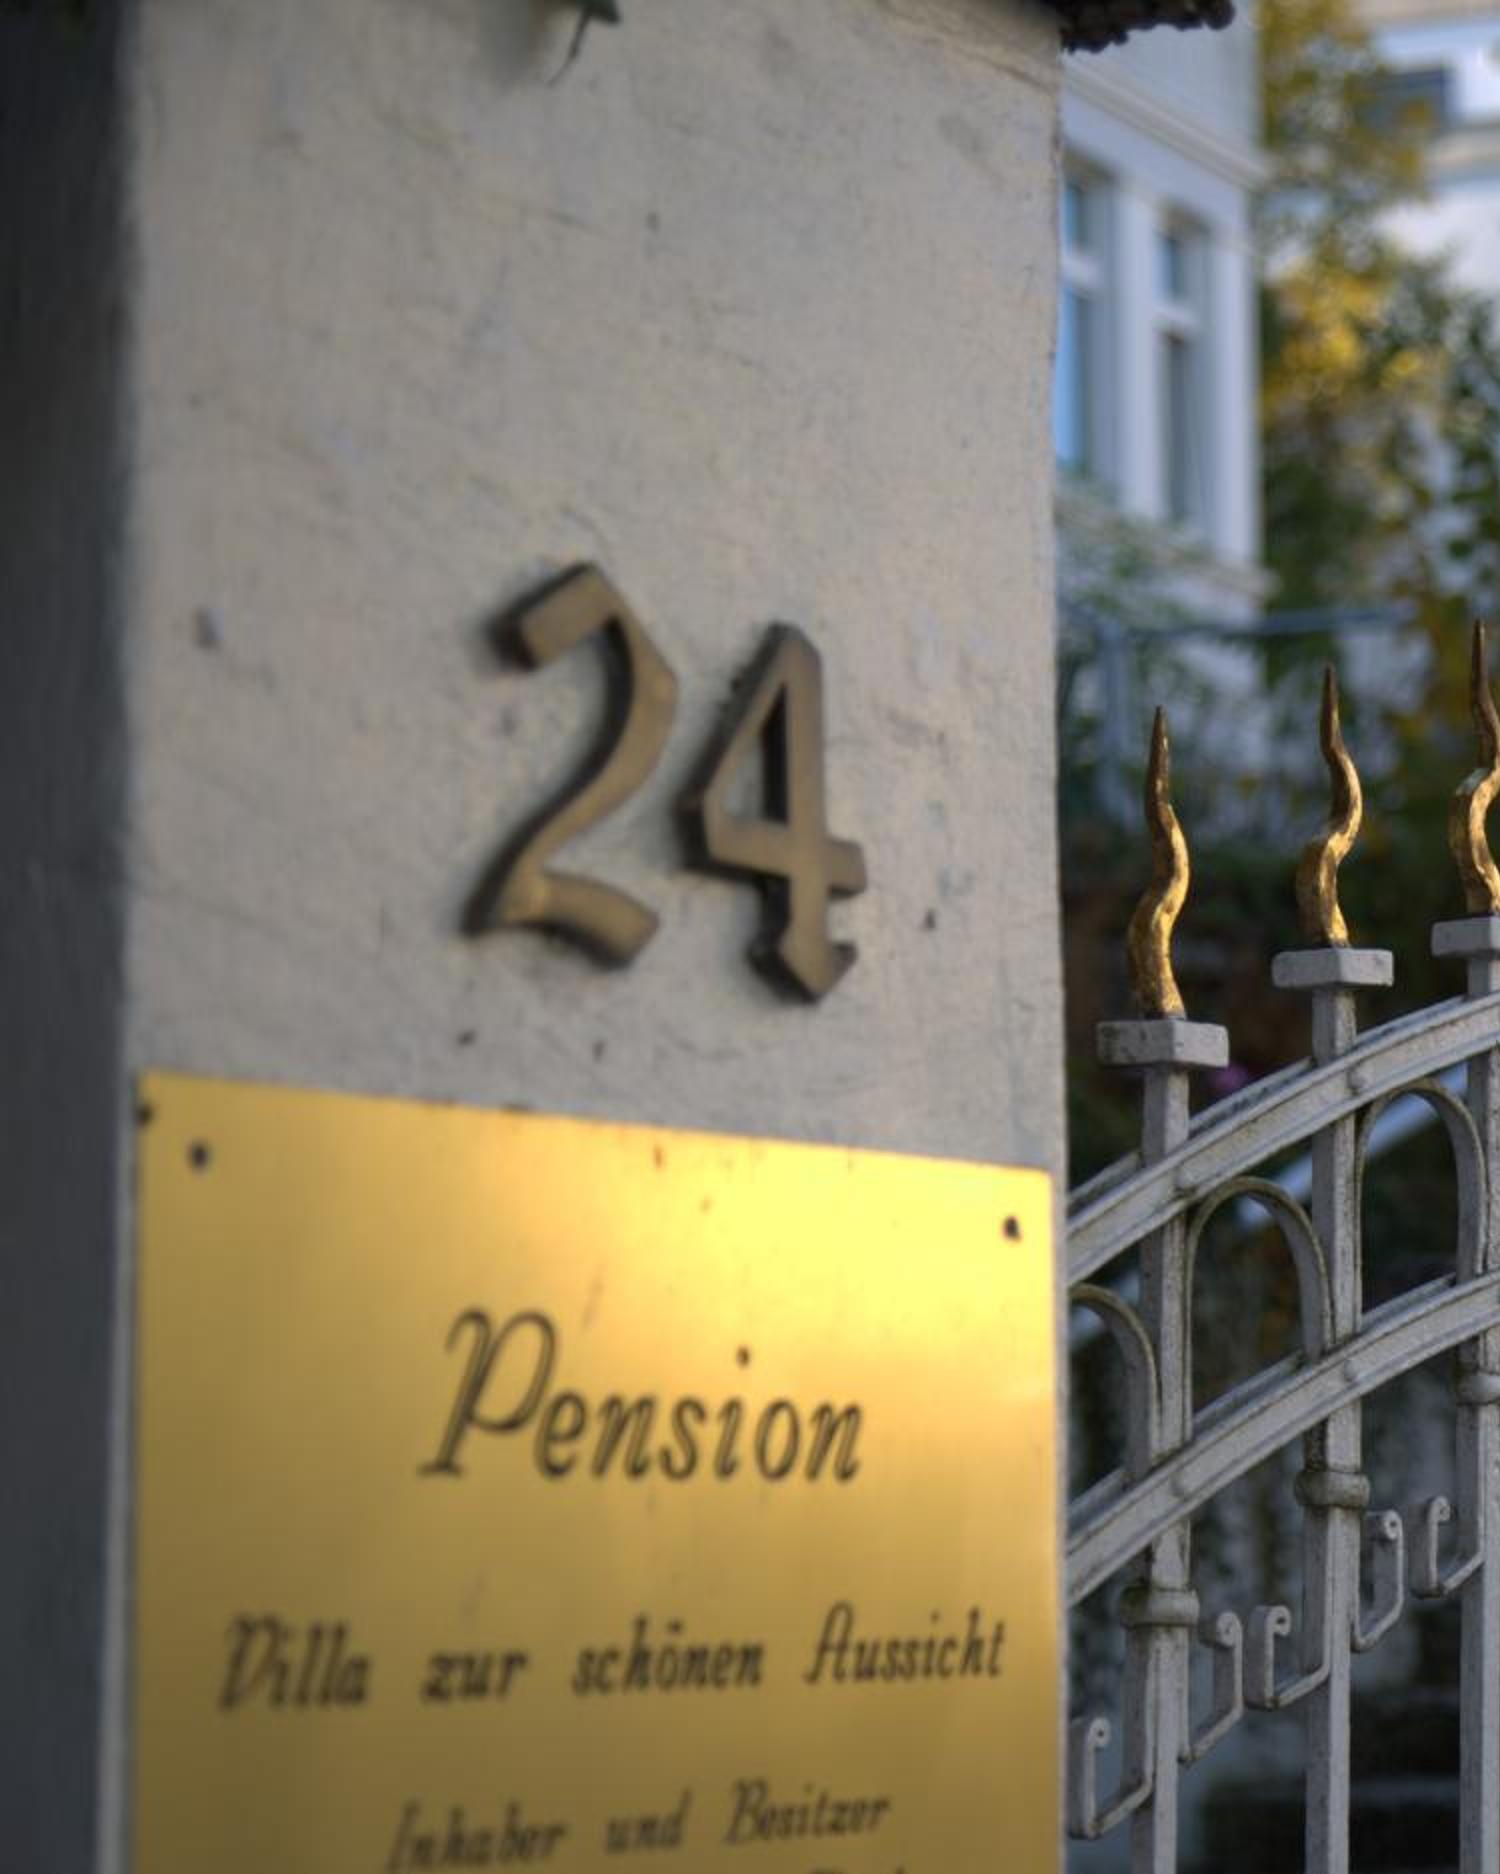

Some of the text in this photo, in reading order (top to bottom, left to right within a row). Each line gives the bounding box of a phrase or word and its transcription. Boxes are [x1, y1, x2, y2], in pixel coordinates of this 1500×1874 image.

[464, 562, 868, 1006] 24
[416, 1305, 864, 1482] Pension
[217, 1602, 1006, 1716] Villa zur schönen Aussicht
[388, 1780, 892, 1873] Inhaber und Besitzer
